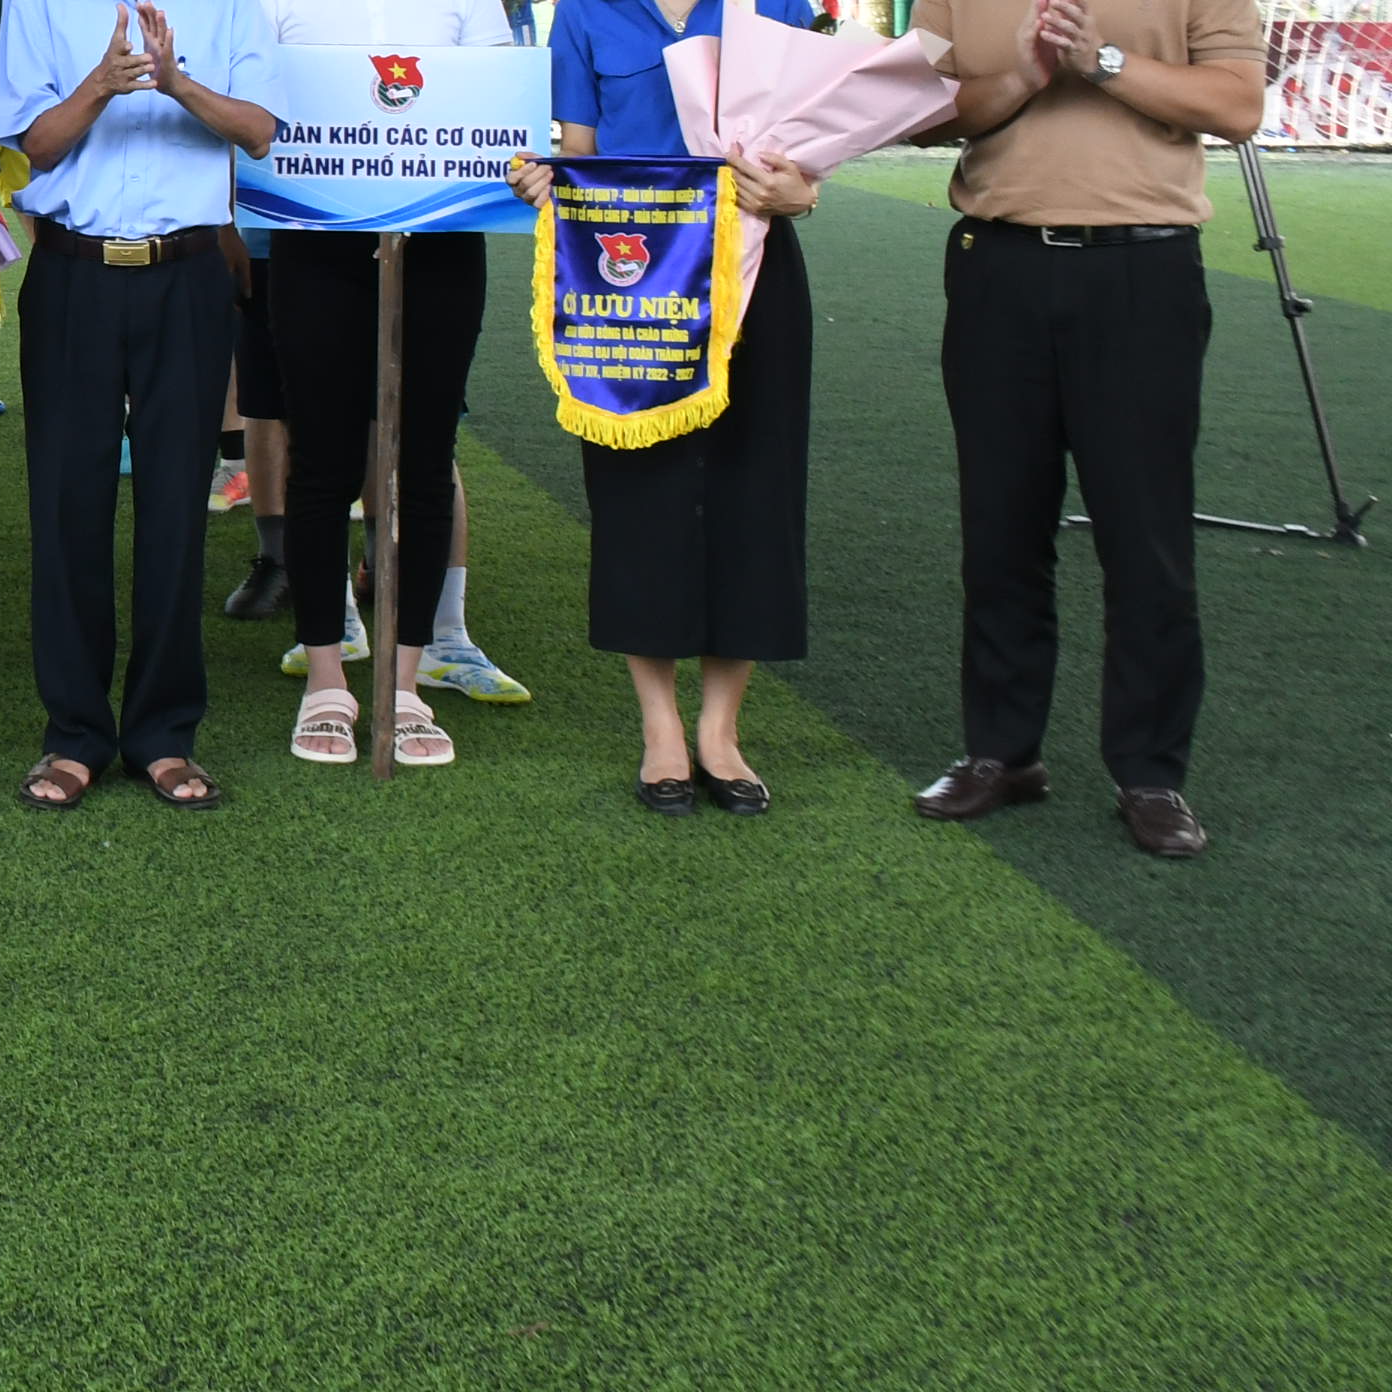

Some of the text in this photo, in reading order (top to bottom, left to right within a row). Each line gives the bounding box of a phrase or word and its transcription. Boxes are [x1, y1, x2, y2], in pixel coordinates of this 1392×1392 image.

[274, 120, 528, 149] OÀN KHỐI CÁC CƠ QUAN
[274, 153, 344, 176] THÀNH
[351, 152, 394, 176] PHỐ
[401, 153, 436, 177] HẢI
[581, 293, 633, 317] LƯU
[639, 290, 700, 325] NIỆM
